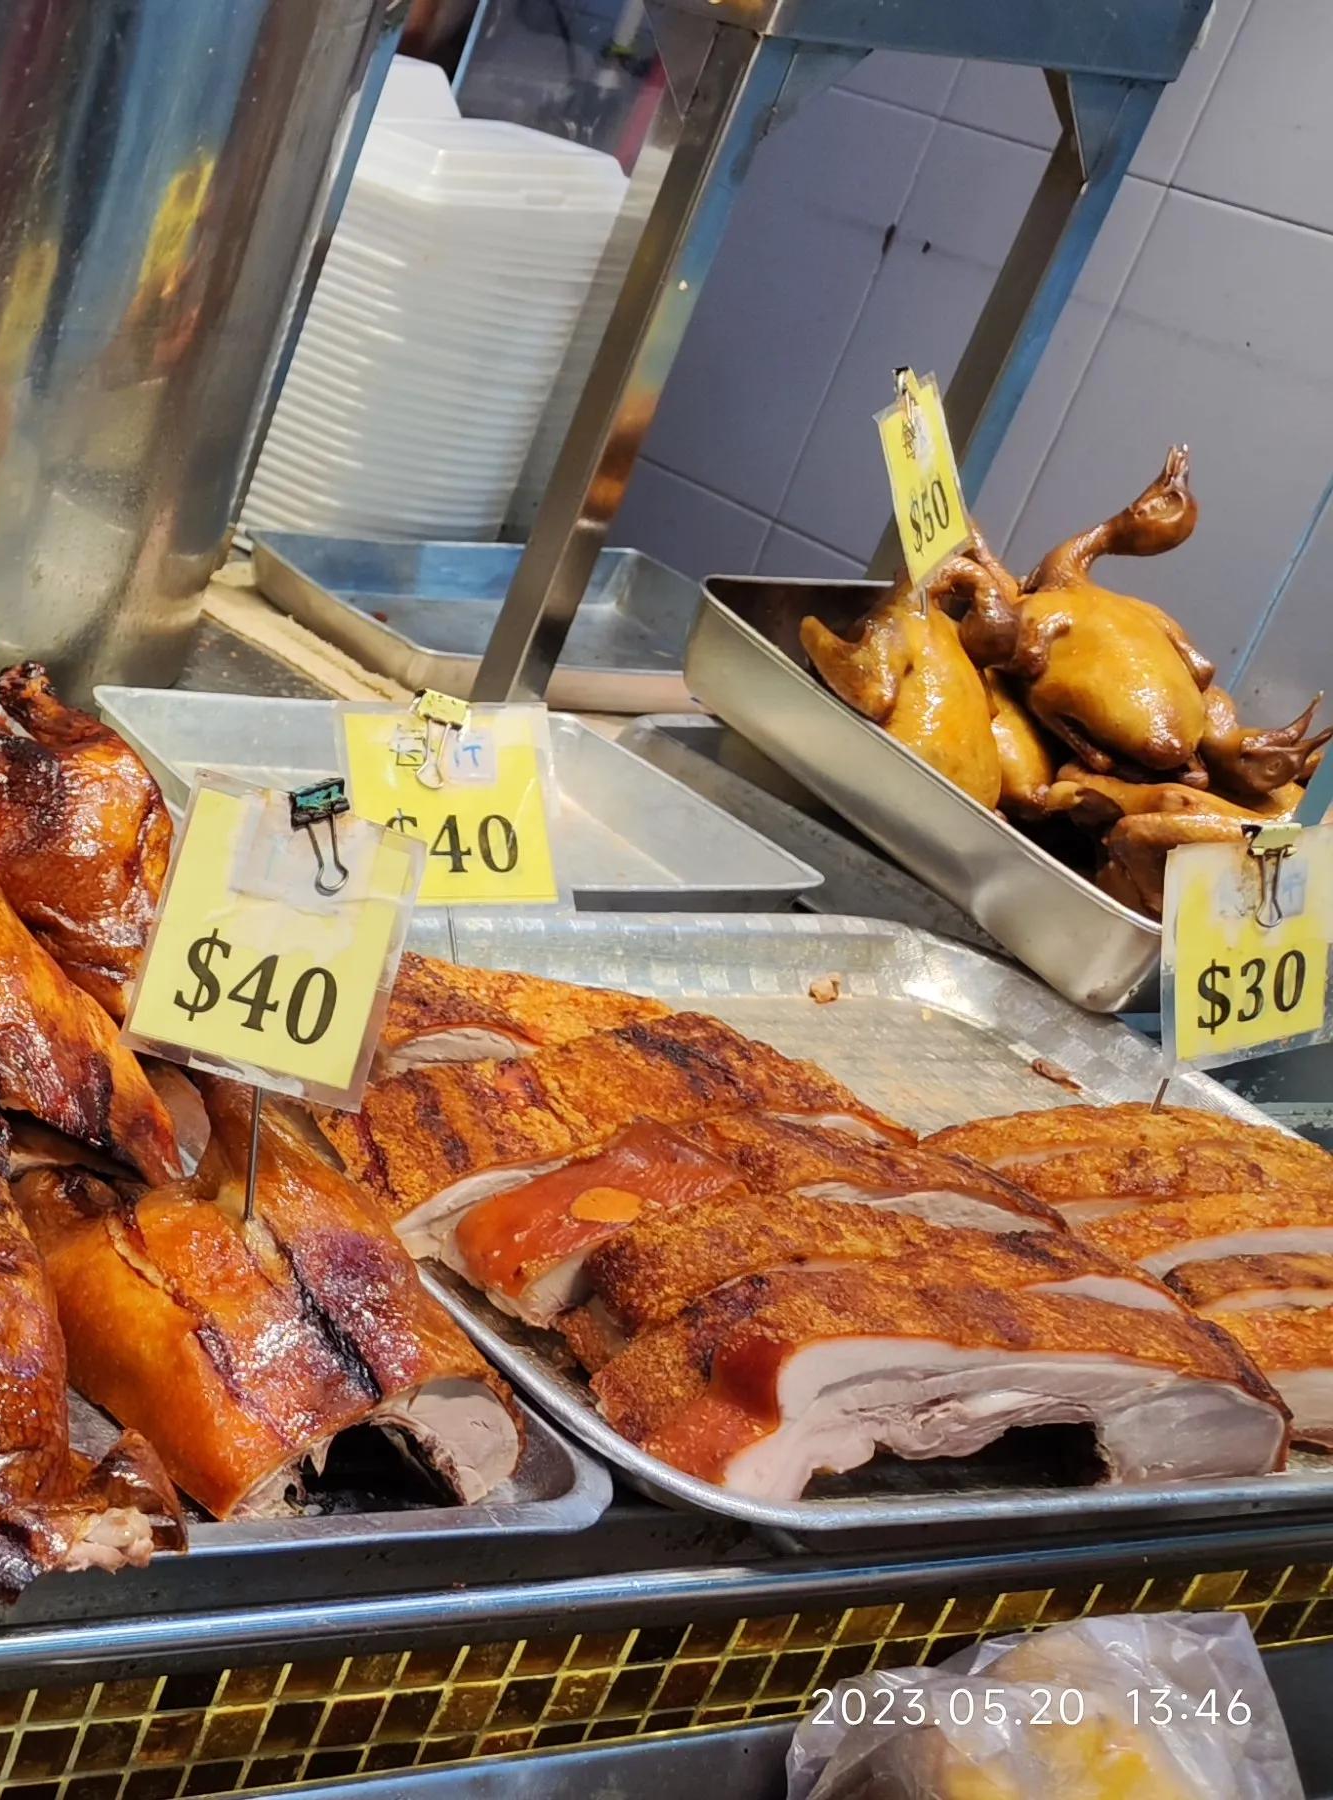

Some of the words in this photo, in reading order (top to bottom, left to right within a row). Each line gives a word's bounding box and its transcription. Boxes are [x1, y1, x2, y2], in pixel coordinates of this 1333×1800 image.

[909, 478, 950, 557] $50
[173, 927, 339, 1046] $40
[1197, 949, 1306, 1035] $30
